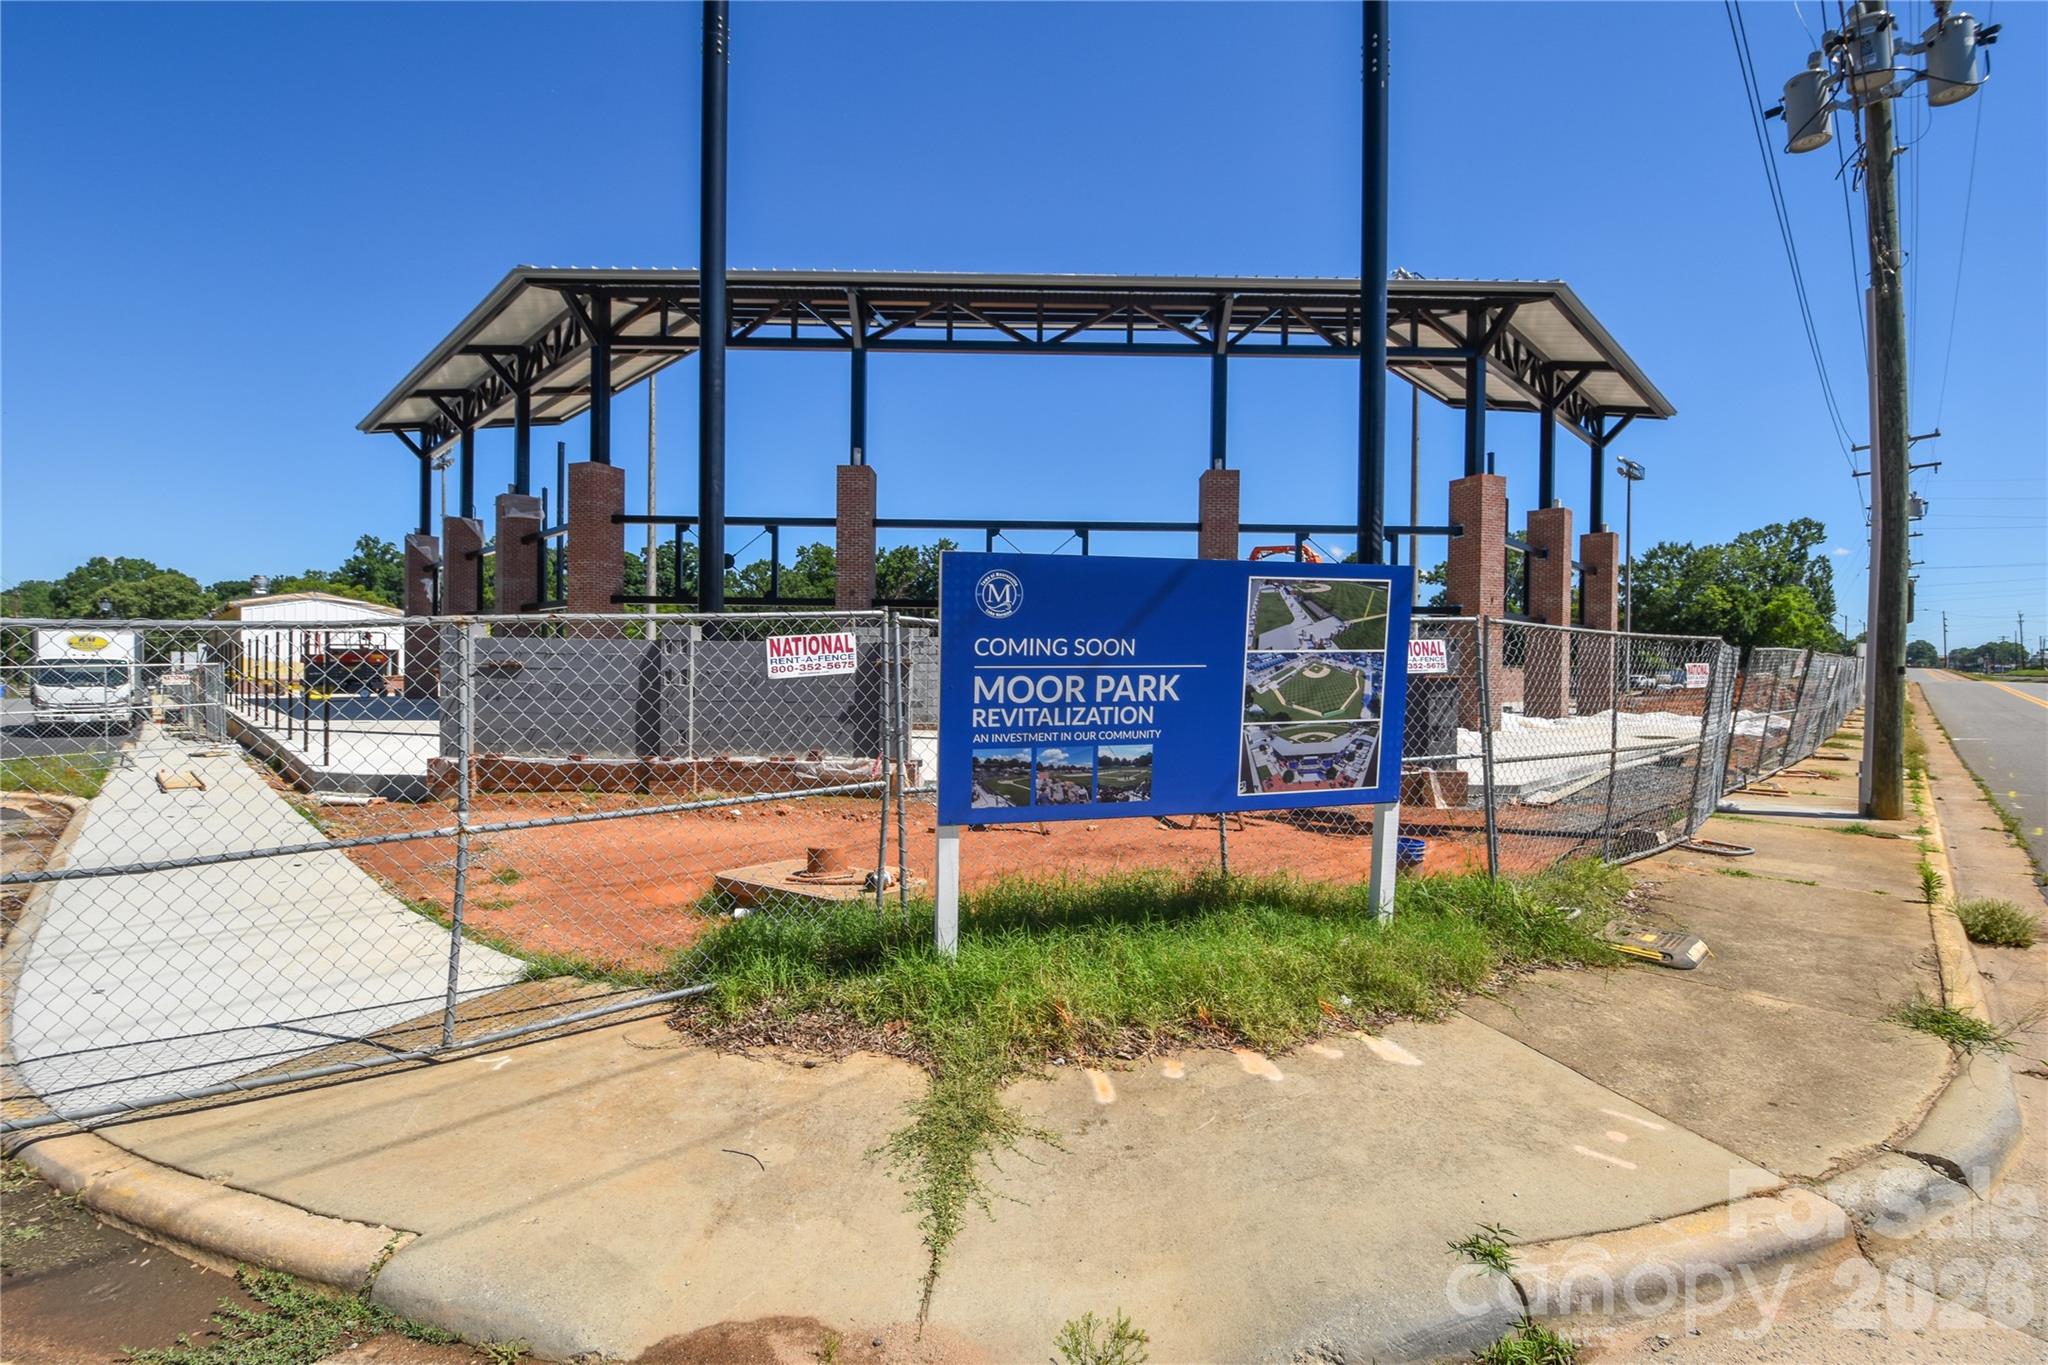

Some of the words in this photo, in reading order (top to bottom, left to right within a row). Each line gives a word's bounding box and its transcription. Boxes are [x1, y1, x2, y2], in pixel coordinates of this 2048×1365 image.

[986, 583, 1012, 603] M
[769, 635, 854, 657] NATIONAL
[974, 637, 1068, 657] COMING
[1073, 637, 1136, 657] SOON
[1408, 641, 1445, 657] IONAL
[770, 653, 855, 666] RENT-A-FENCE
[770, 660, 855, 674] 800-352-5675
[973, 675, 1086, 705] MOOR
[1095, 674, 1181, 703] PARK
[972, 705, 1154, 728] REVITALIZATION
[972, 733, 989, 744] AN
[991, 731, 1059, 744] INVESTMENT
[1060, 731, 1072, 742] IN
[1074, 731, 1097, 742] OUR
[1098, 729, 1162, 741] COMMUNITY
